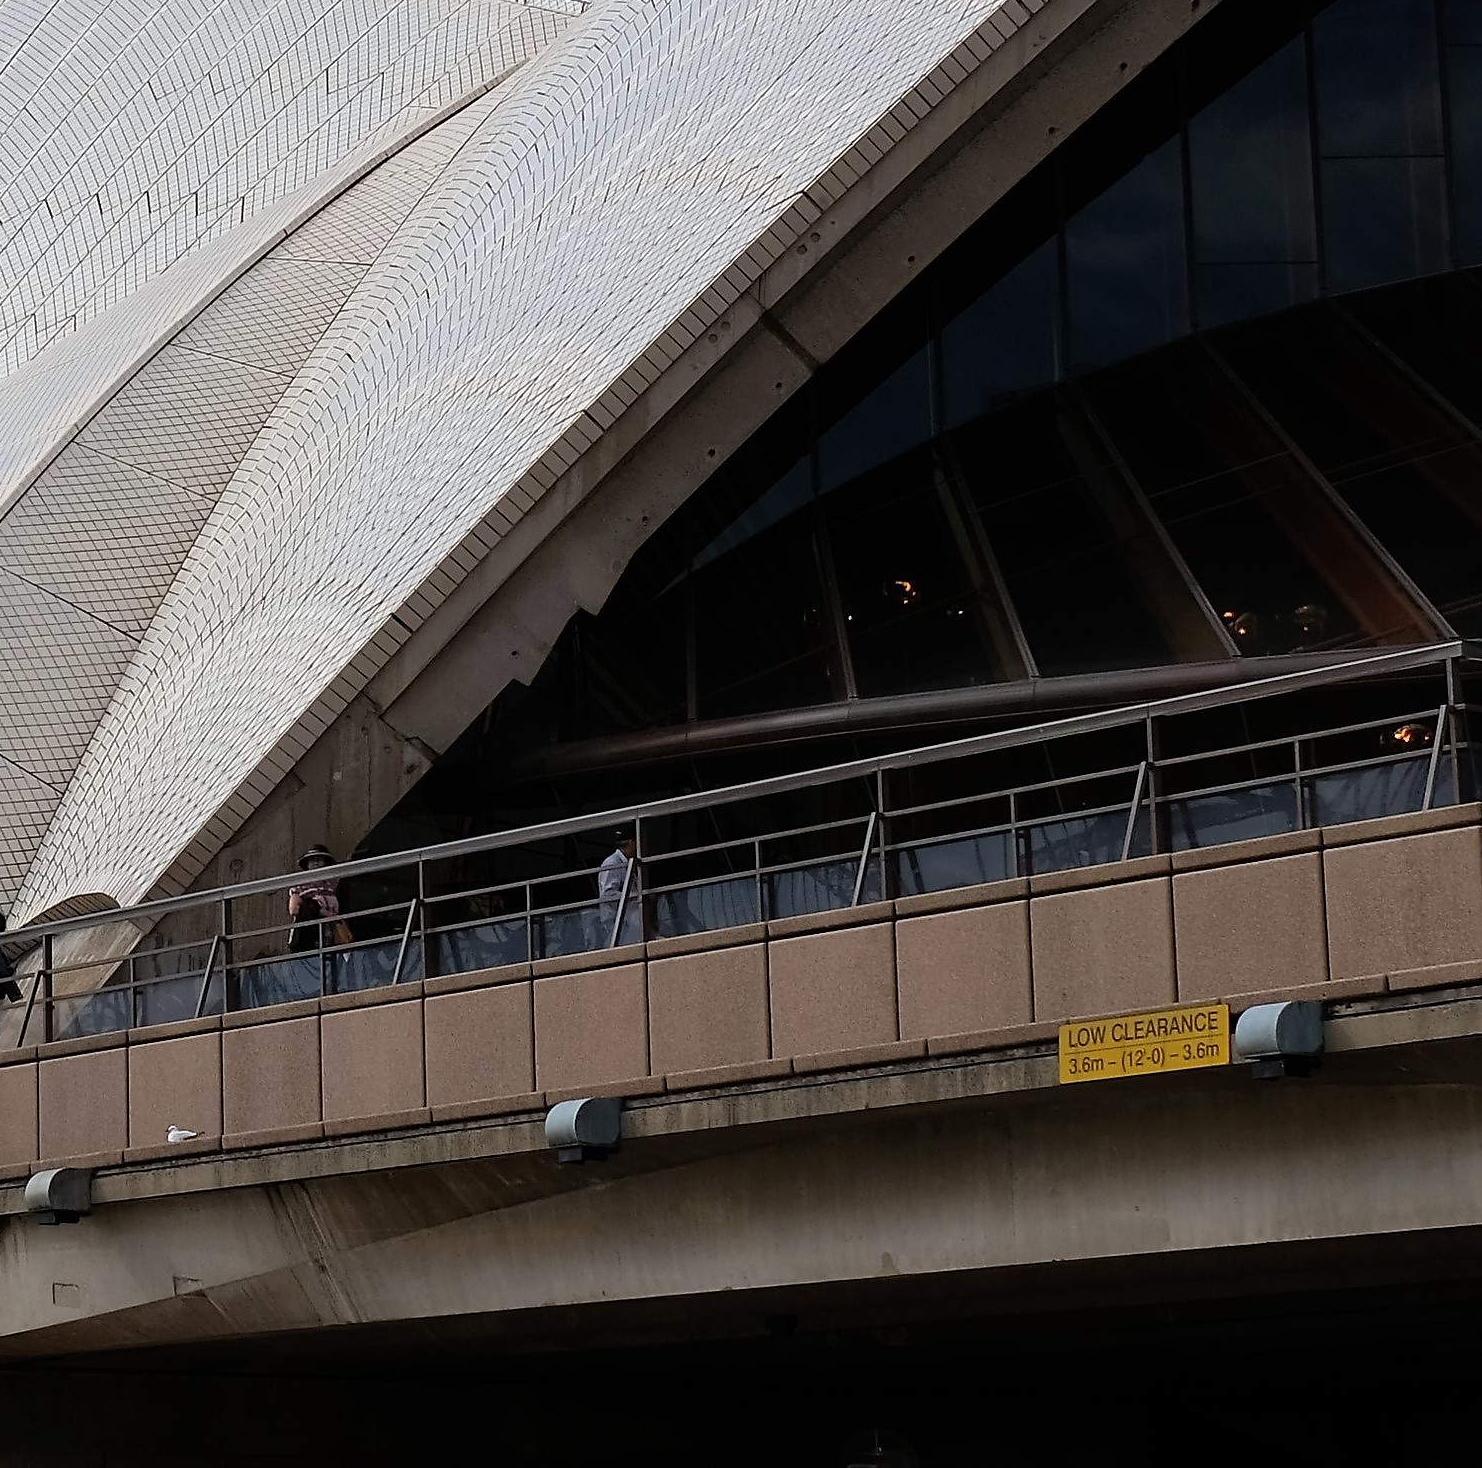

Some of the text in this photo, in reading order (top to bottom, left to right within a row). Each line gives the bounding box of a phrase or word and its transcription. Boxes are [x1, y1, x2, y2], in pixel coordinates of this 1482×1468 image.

[1068, 1011, 1218, 1048] LOW CLEARANCE
[1068, 1056, 1104, 1074] 3.6m
[1183, 1042, 1220, 1061] 3.6m
